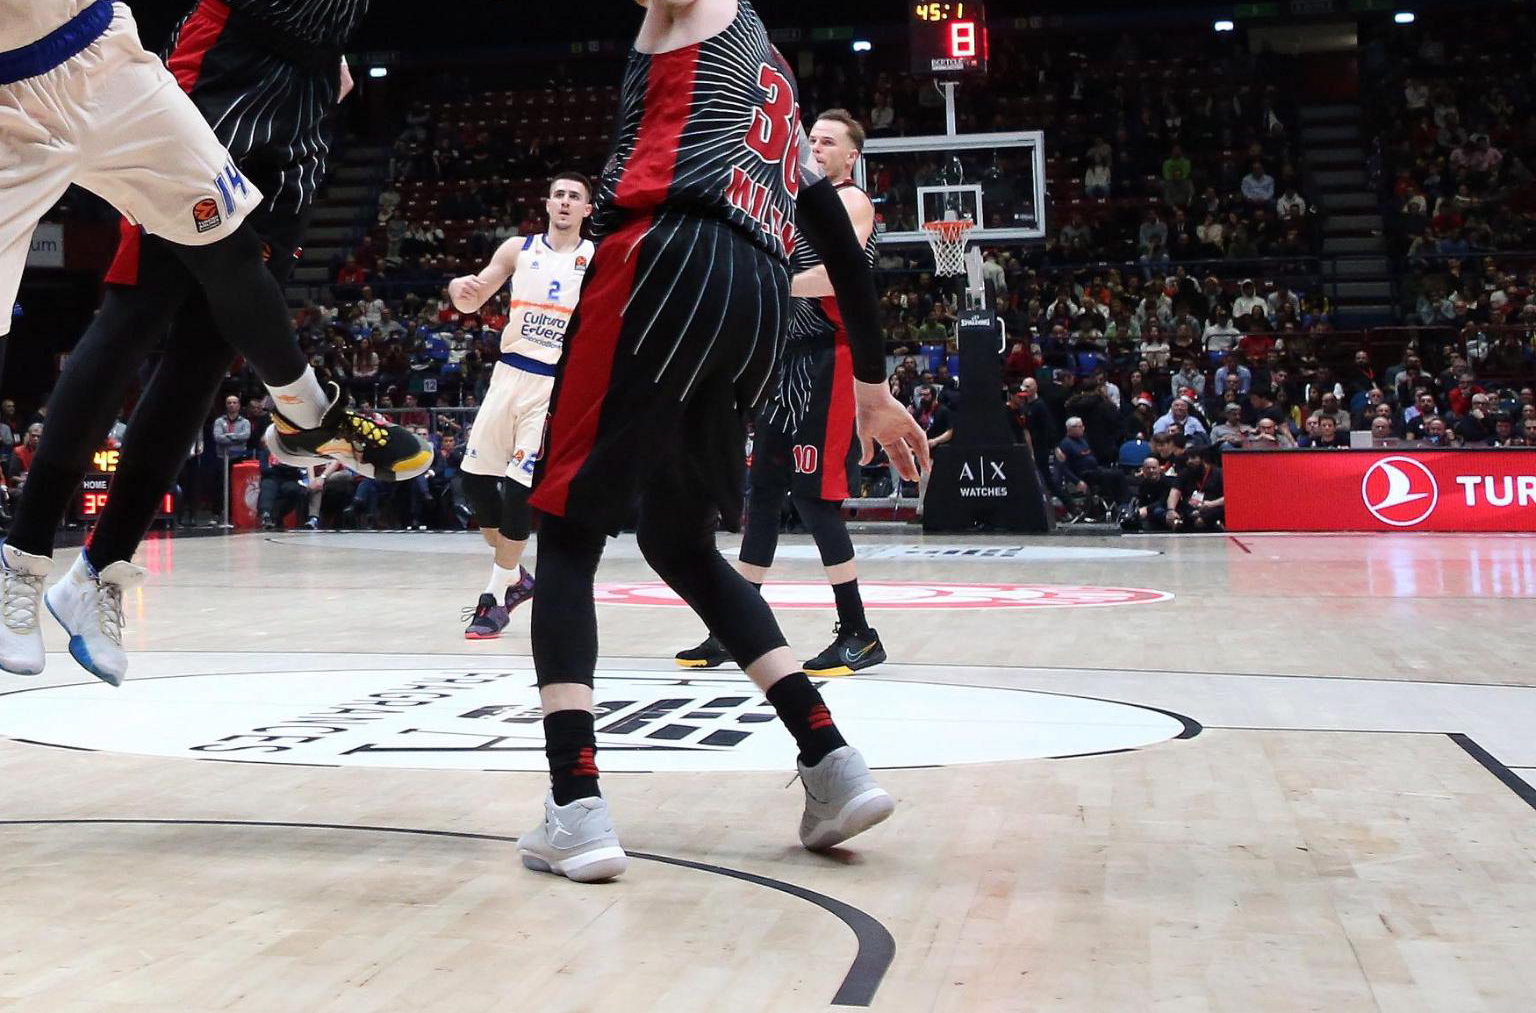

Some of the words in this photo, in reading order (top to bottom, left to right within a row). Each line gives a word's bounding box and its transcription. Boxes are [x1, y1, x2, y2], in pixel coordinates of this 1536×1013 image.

[950, 21, 976, 57] 8
[214, 153, 250, 220] 14
[548, 280, 561, 299] 2
[523, 311, 566, 329] Cultura
[792, 444, 818, 475] 10
[83, 480, 107, 489] HOME
[959, 487, 1008, 497] WATCHES
[1455, 475, 1536, 507] TUR
[189, 671, 513, 753] FRAGRANCES
